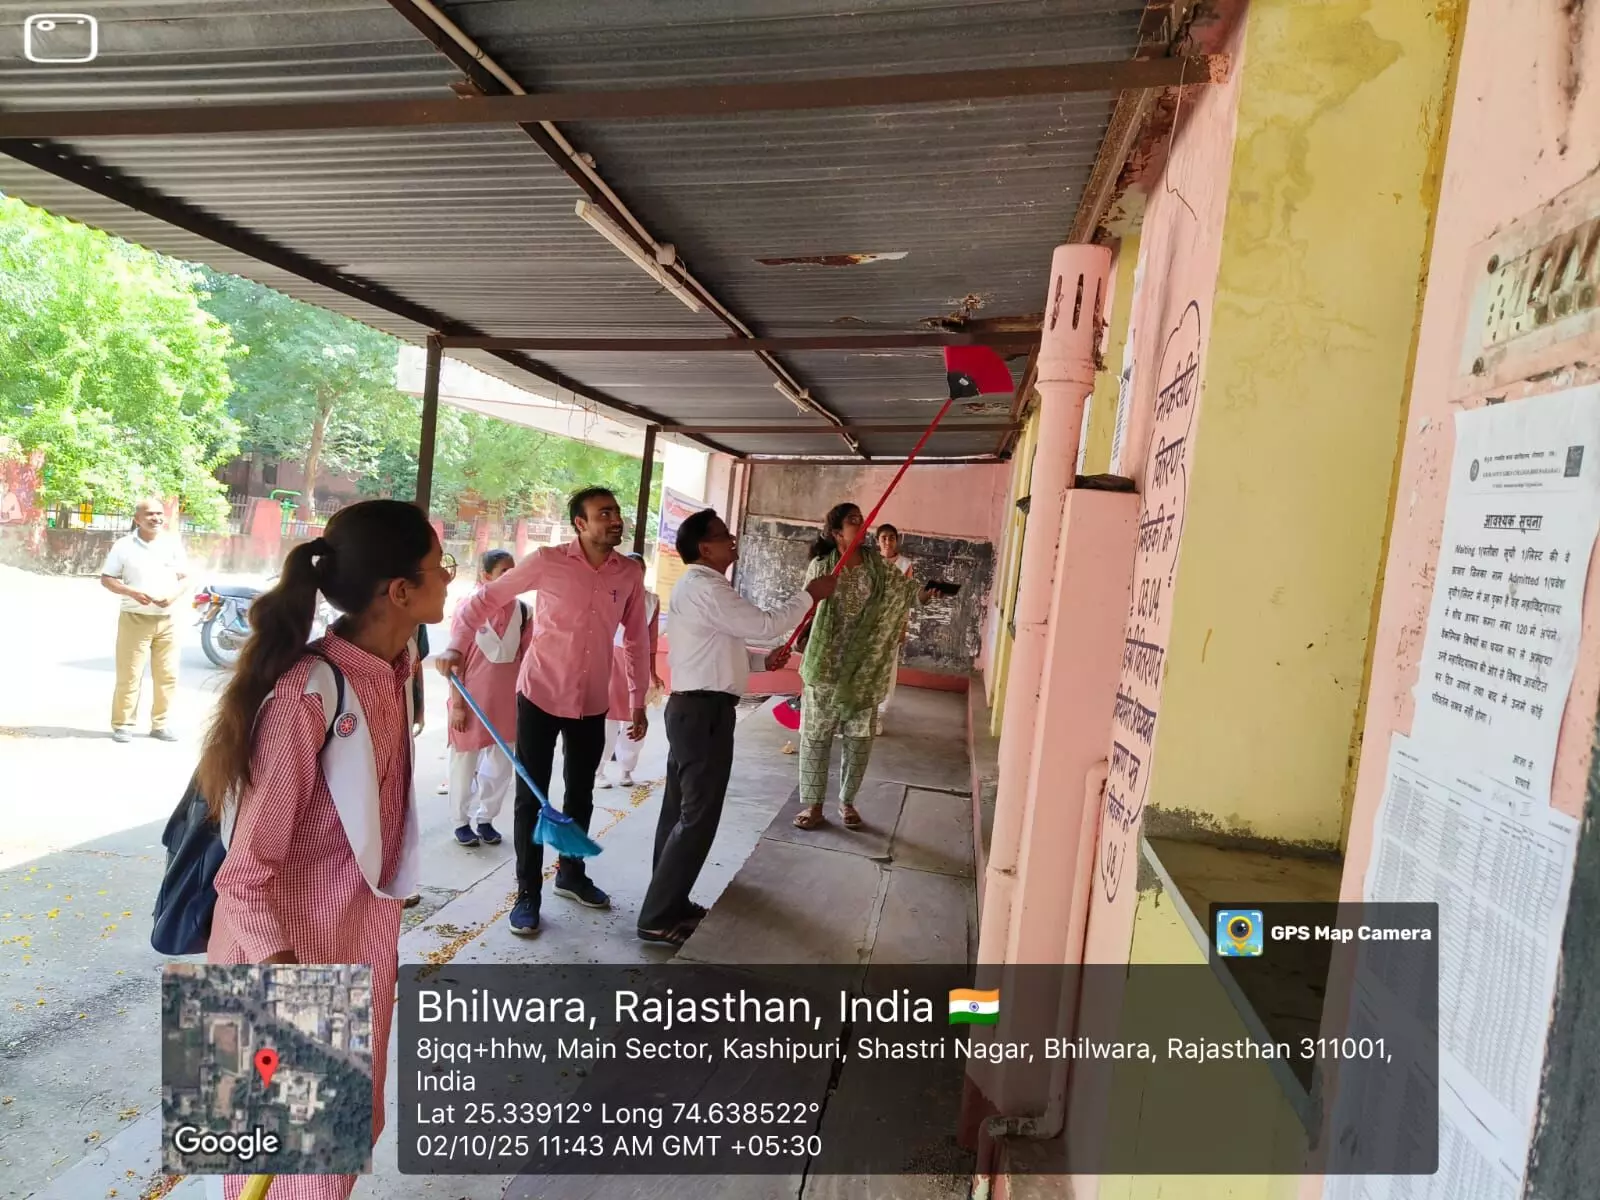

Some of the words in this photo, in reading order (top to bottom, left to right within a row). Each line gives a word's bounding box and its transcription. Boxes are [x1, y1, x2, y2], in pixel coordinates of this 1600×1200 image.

[1483, 514, 1516, 529] आवश्यक
[1519, 514, 1543, 534] सूचना
[1508, 572, 1540, 586] Admitted
[1516, 623, 1528, 635] 120
